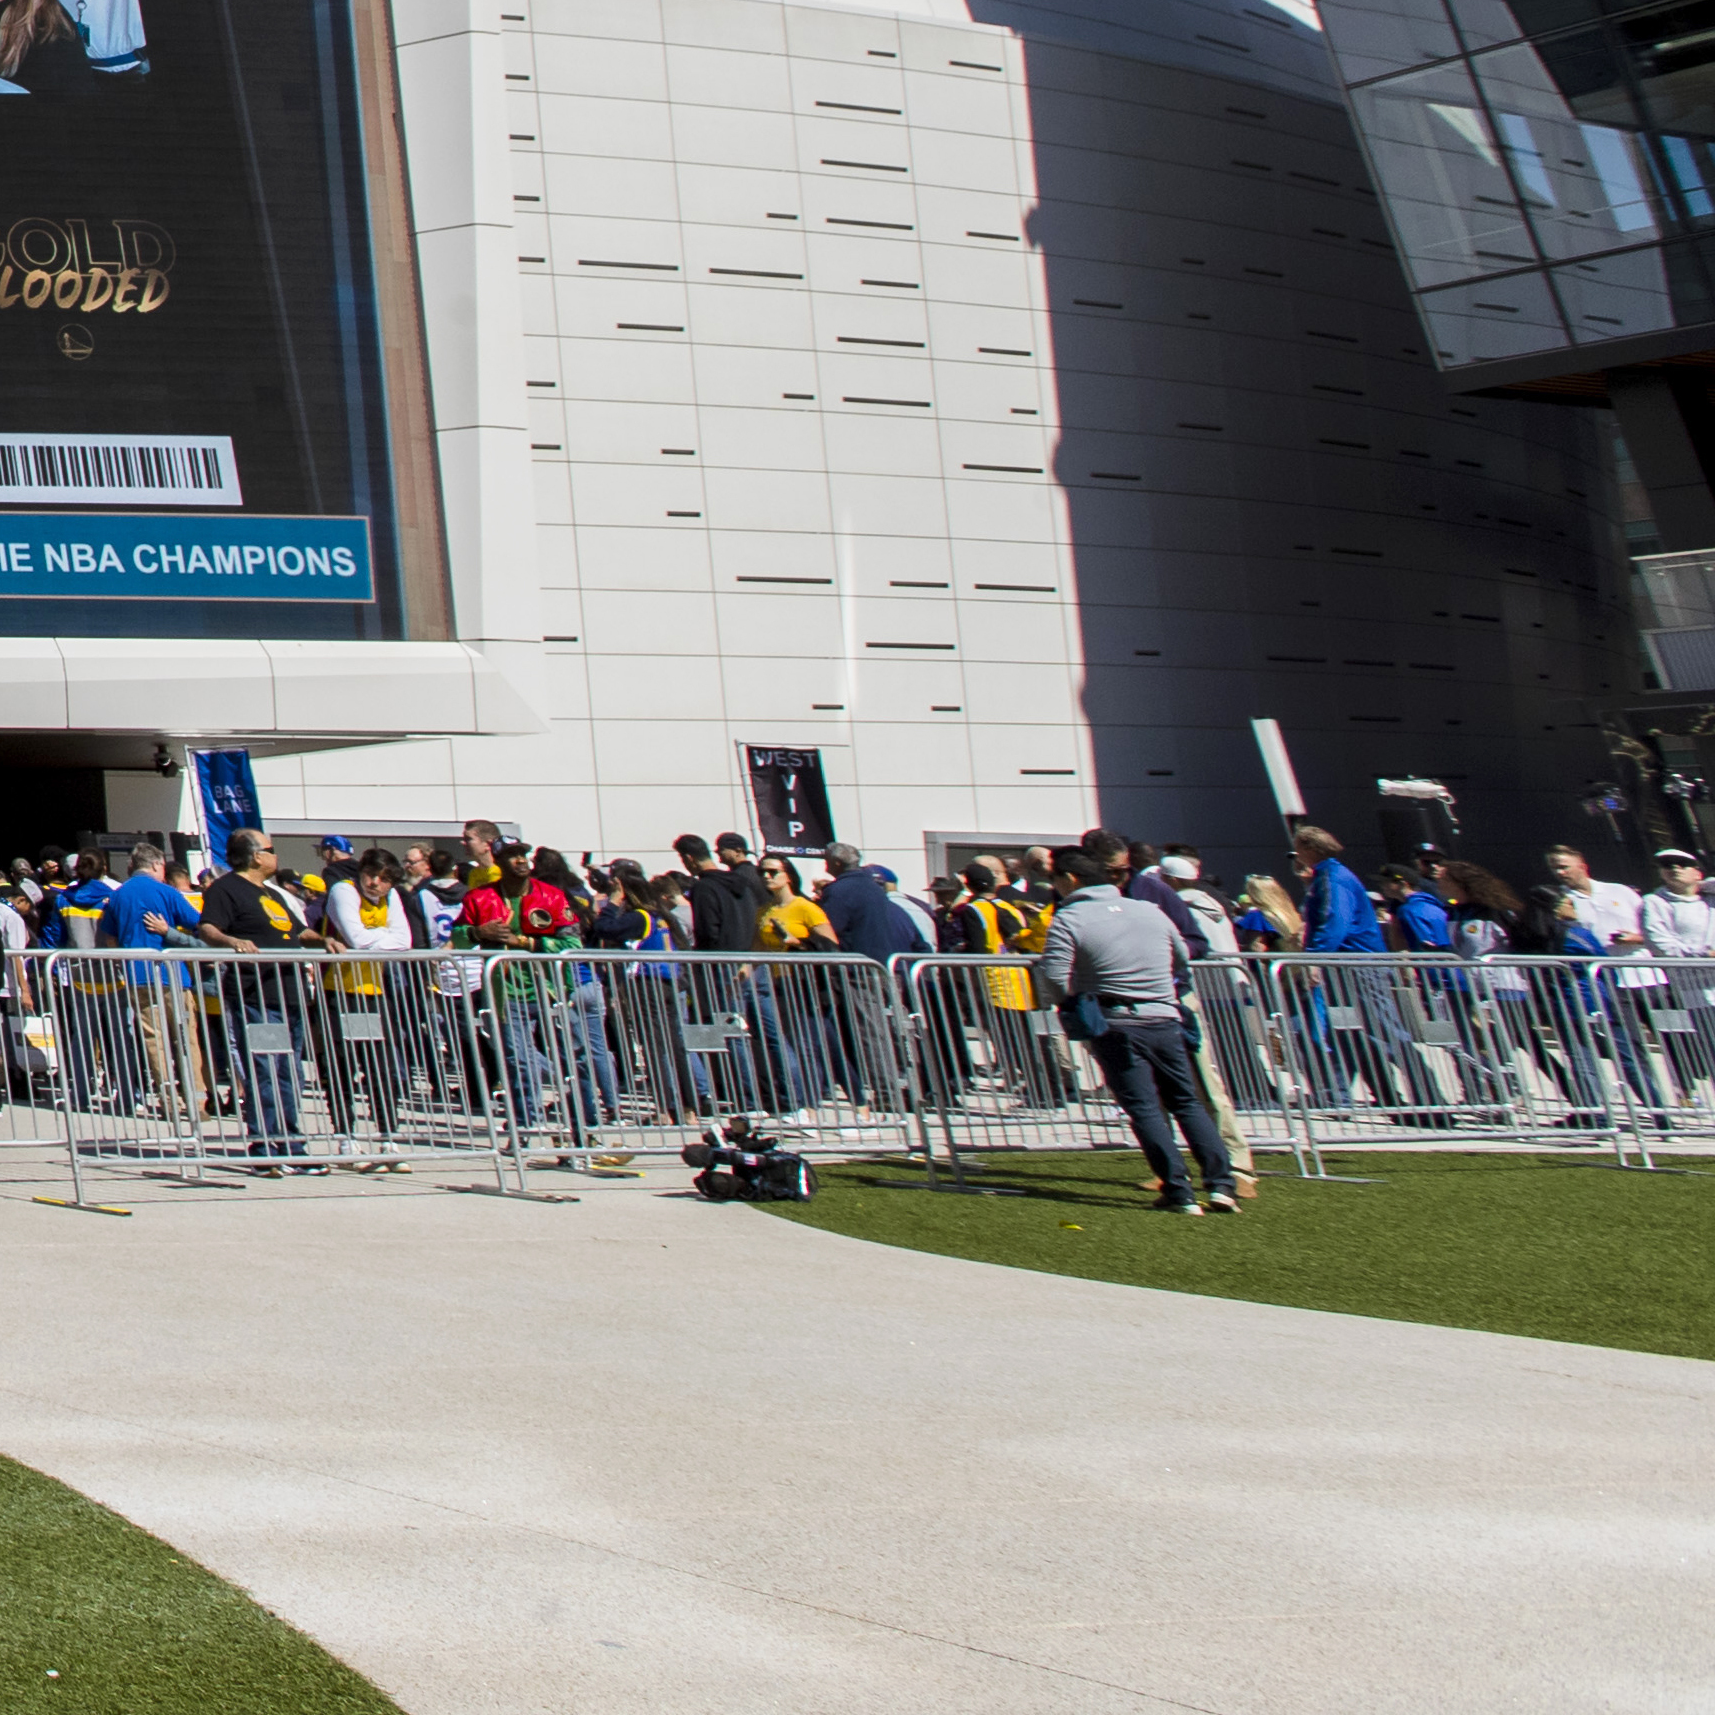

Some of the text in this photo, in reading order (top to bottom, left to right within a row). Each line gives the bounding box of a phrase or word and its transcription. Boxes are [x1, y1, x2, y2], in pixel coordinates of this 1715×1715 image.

[43, 543, 126, 574] NBA
[133, 543, 357, 578] CHAMPIONS
[752, 749, 816, 767] WEST
[215, 785, 245, 799] BAG
[213, 799, 252, 814] LANE
[781, 774, 805, 838] VIP
